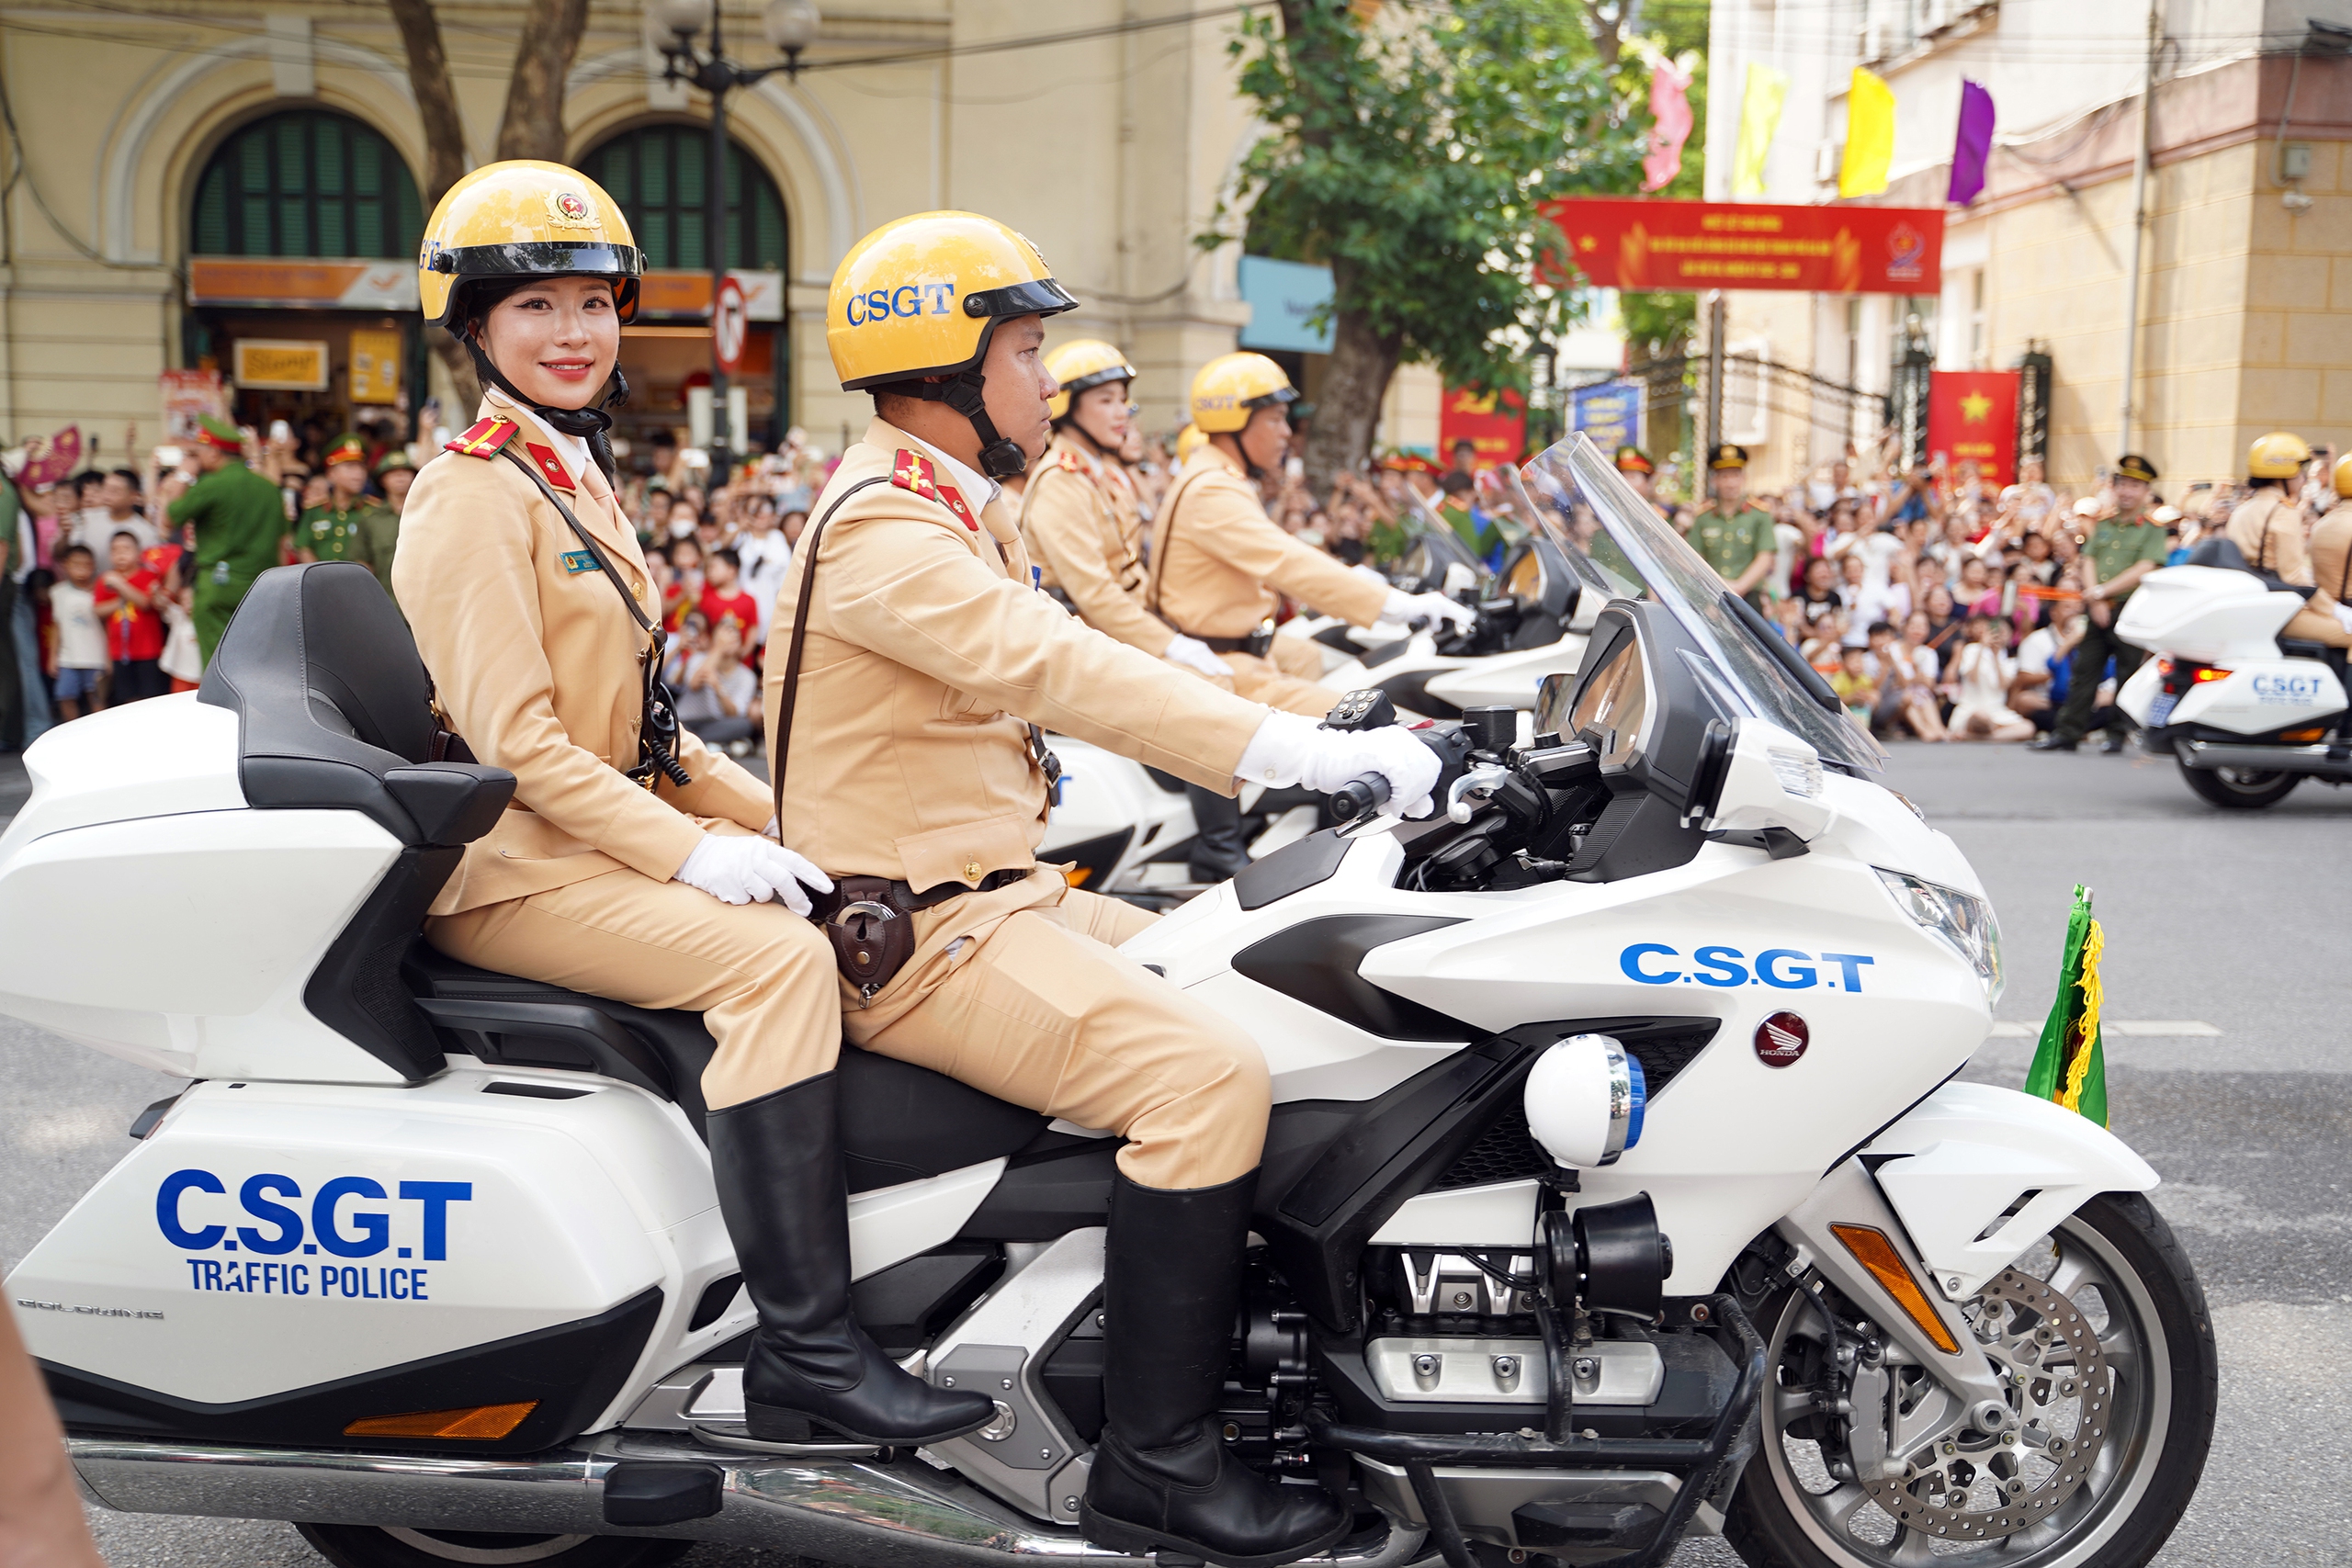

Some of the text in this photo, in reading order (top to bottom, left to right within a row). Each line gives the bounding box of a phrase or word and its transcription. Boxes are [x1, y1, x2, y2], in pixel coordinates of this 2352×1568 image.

[846, 283, 955, 327] CSGT
[1620, 942, 1875, 993] C.S.G.T
[156, 1168, 472, 1261] C.S.G.T
[187, 1258, 429, 1301] TRAFFIC POLICE
[17, 1298, 164, 1319] GOLDWING
